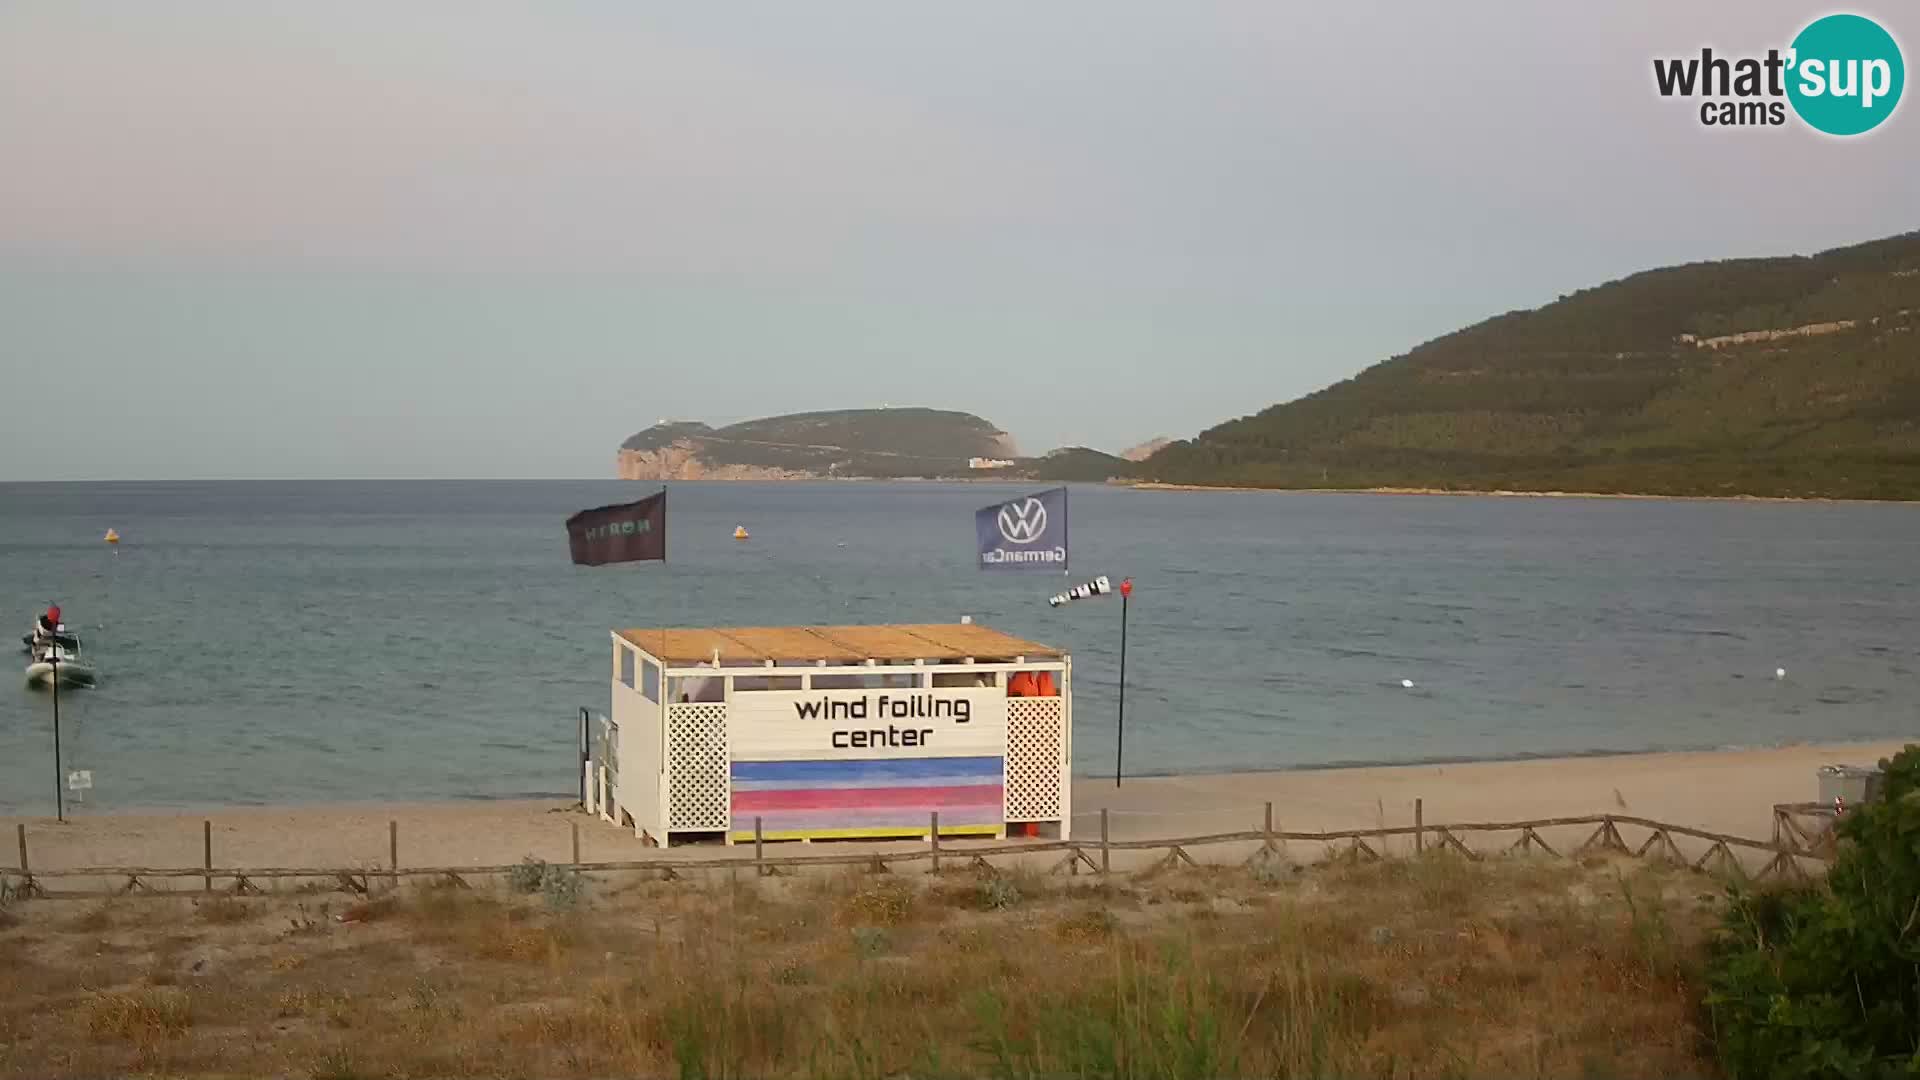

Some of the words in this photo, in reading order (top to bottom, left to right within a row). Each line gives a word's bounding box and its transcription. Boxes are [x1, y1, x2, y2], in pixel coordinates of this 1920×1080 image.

[794, 696, 867, 719] wind
[878, 694, 971, 723] foiling
[832, 725, 934, 749] center
